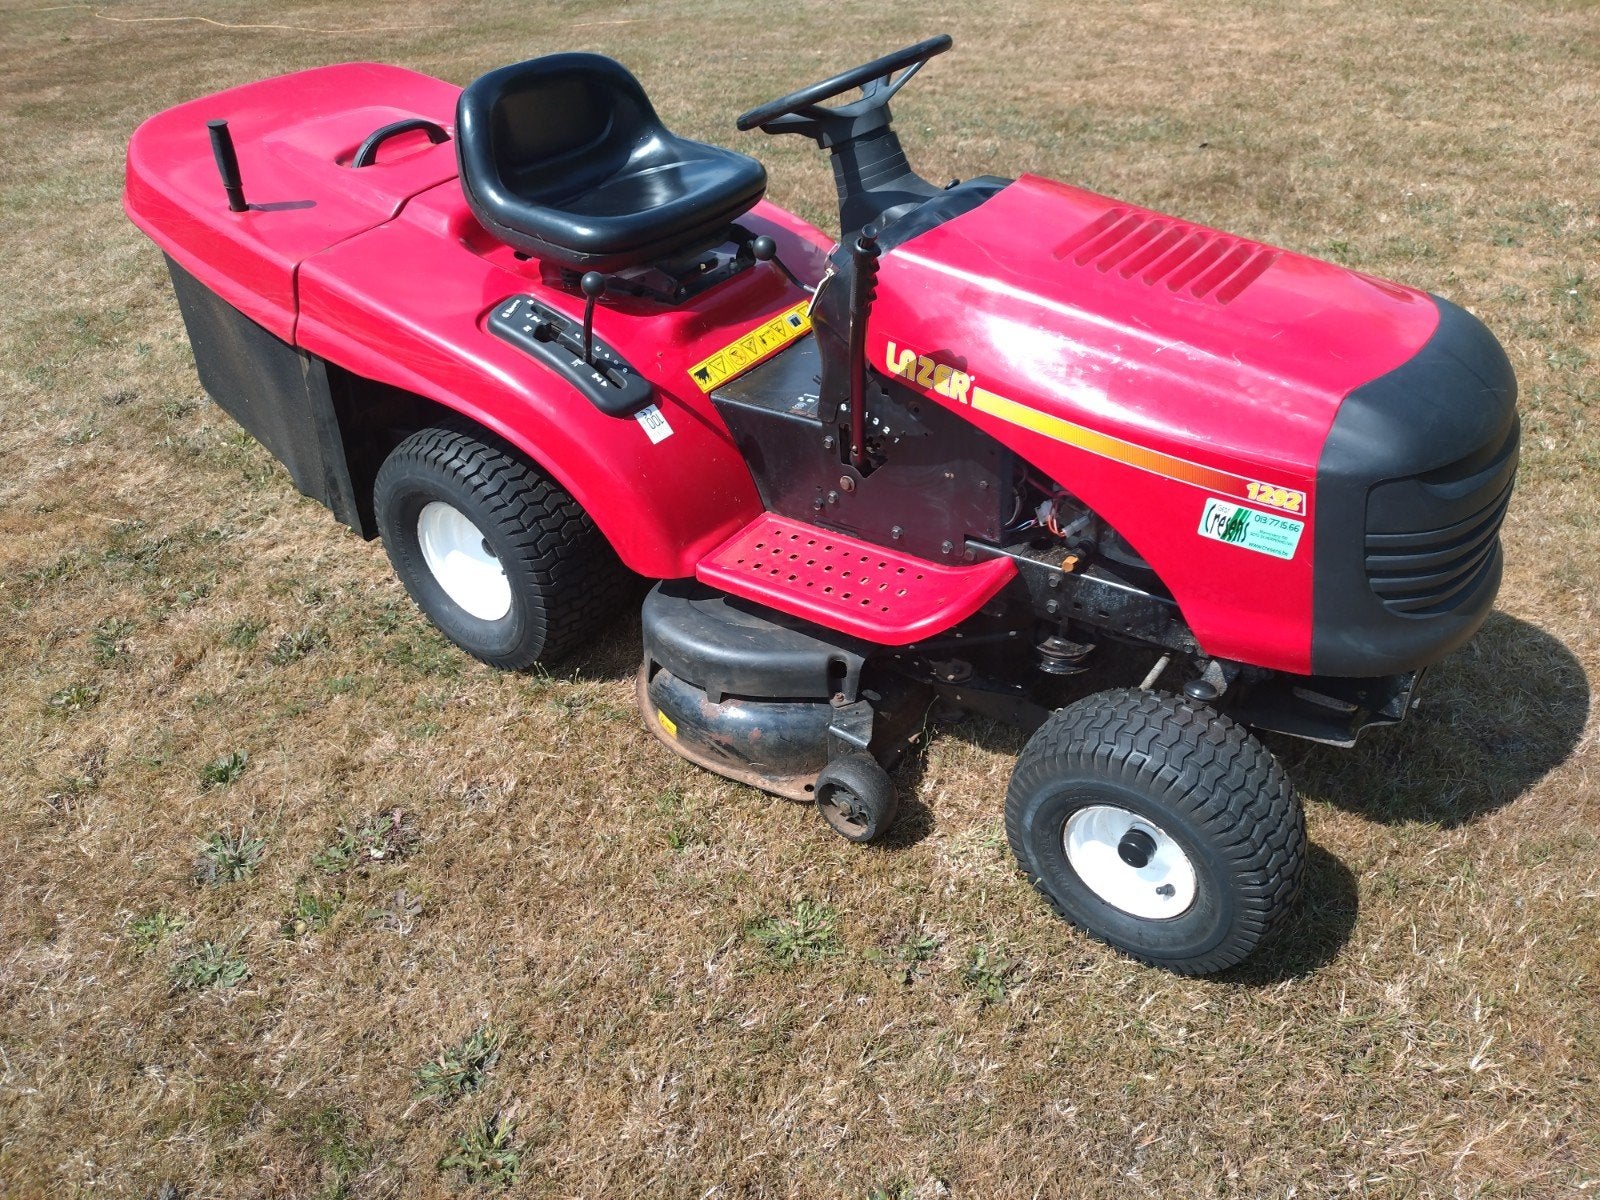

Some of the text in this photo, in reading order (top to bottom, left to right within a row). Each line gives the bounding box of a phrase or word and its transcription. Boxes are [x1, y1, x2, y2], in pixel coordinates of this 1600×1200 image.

[885, 340, 971, 404] LAZER
[646, 413, 665, 429] 100
[872, 417, 880, 425] 3
[882, 426, 891, 435] 2
[1246, 482, 1303, 511] 1292
[1205, 504, 1250, 543] Cresens
